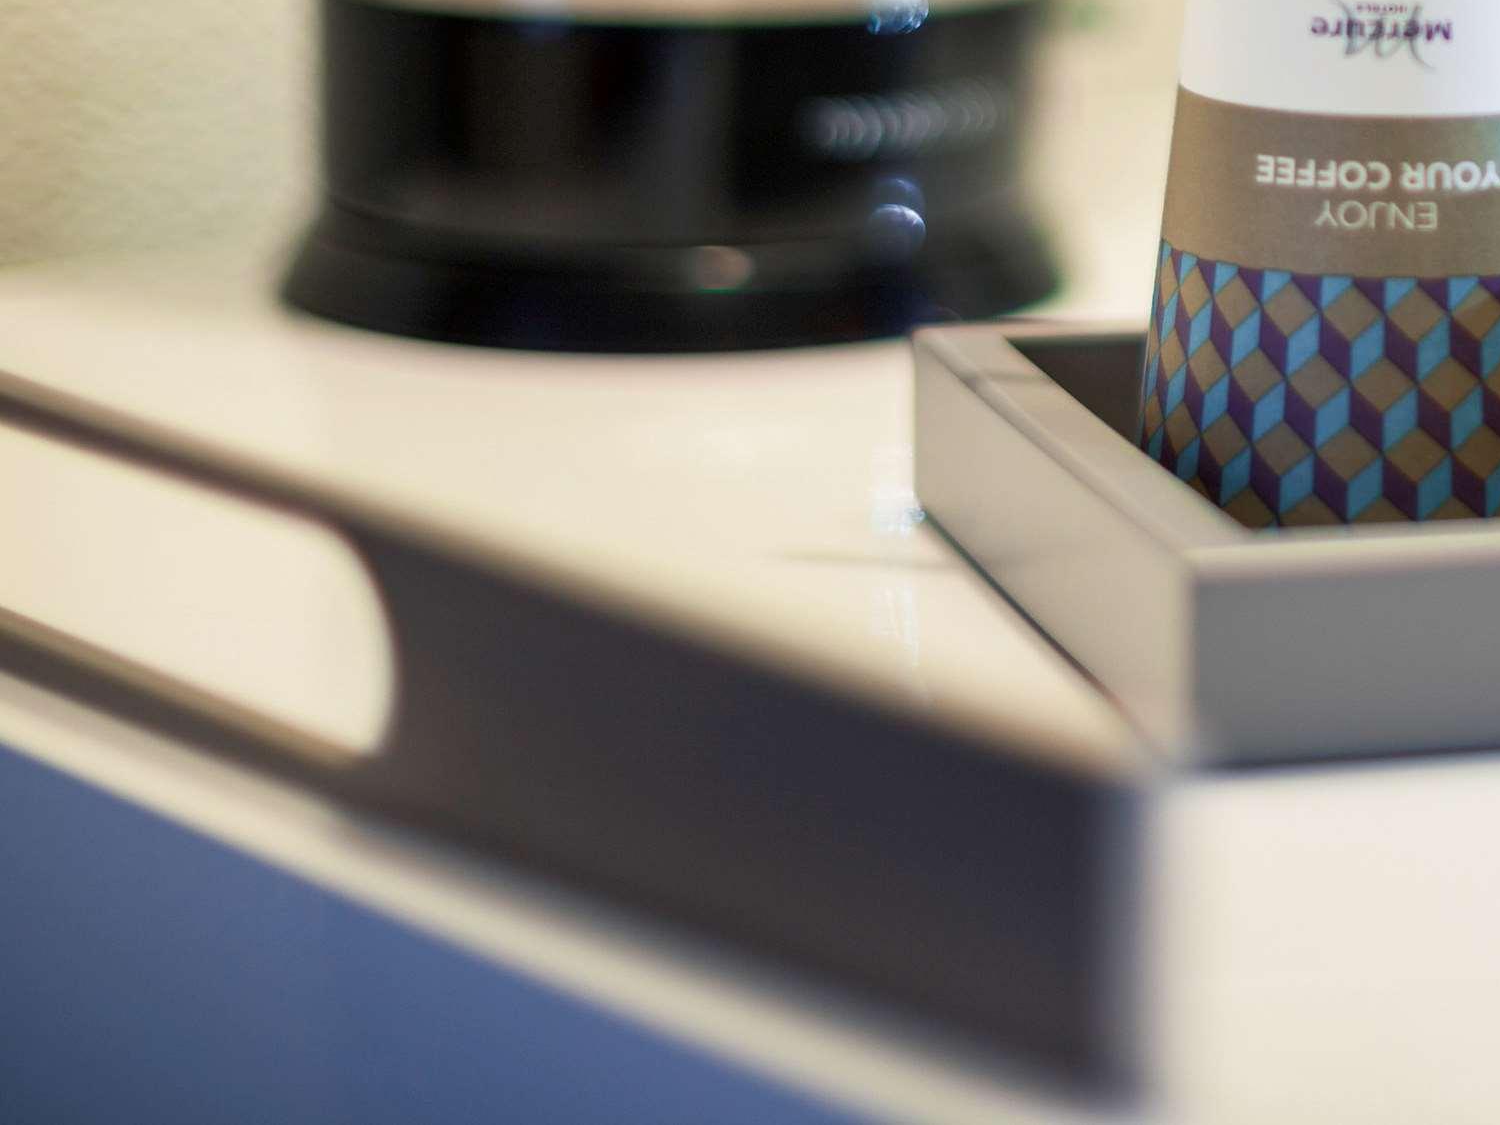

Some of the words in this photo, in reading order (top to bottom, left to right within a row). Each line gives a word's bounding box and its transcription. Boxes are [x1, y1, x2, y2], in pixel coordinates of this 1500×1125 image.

[1311, 17, 1453, 41] Mercure
[1256, 154, 1390, 190] COFFEE
[1314, 201, 1438, 230] ENJOY
